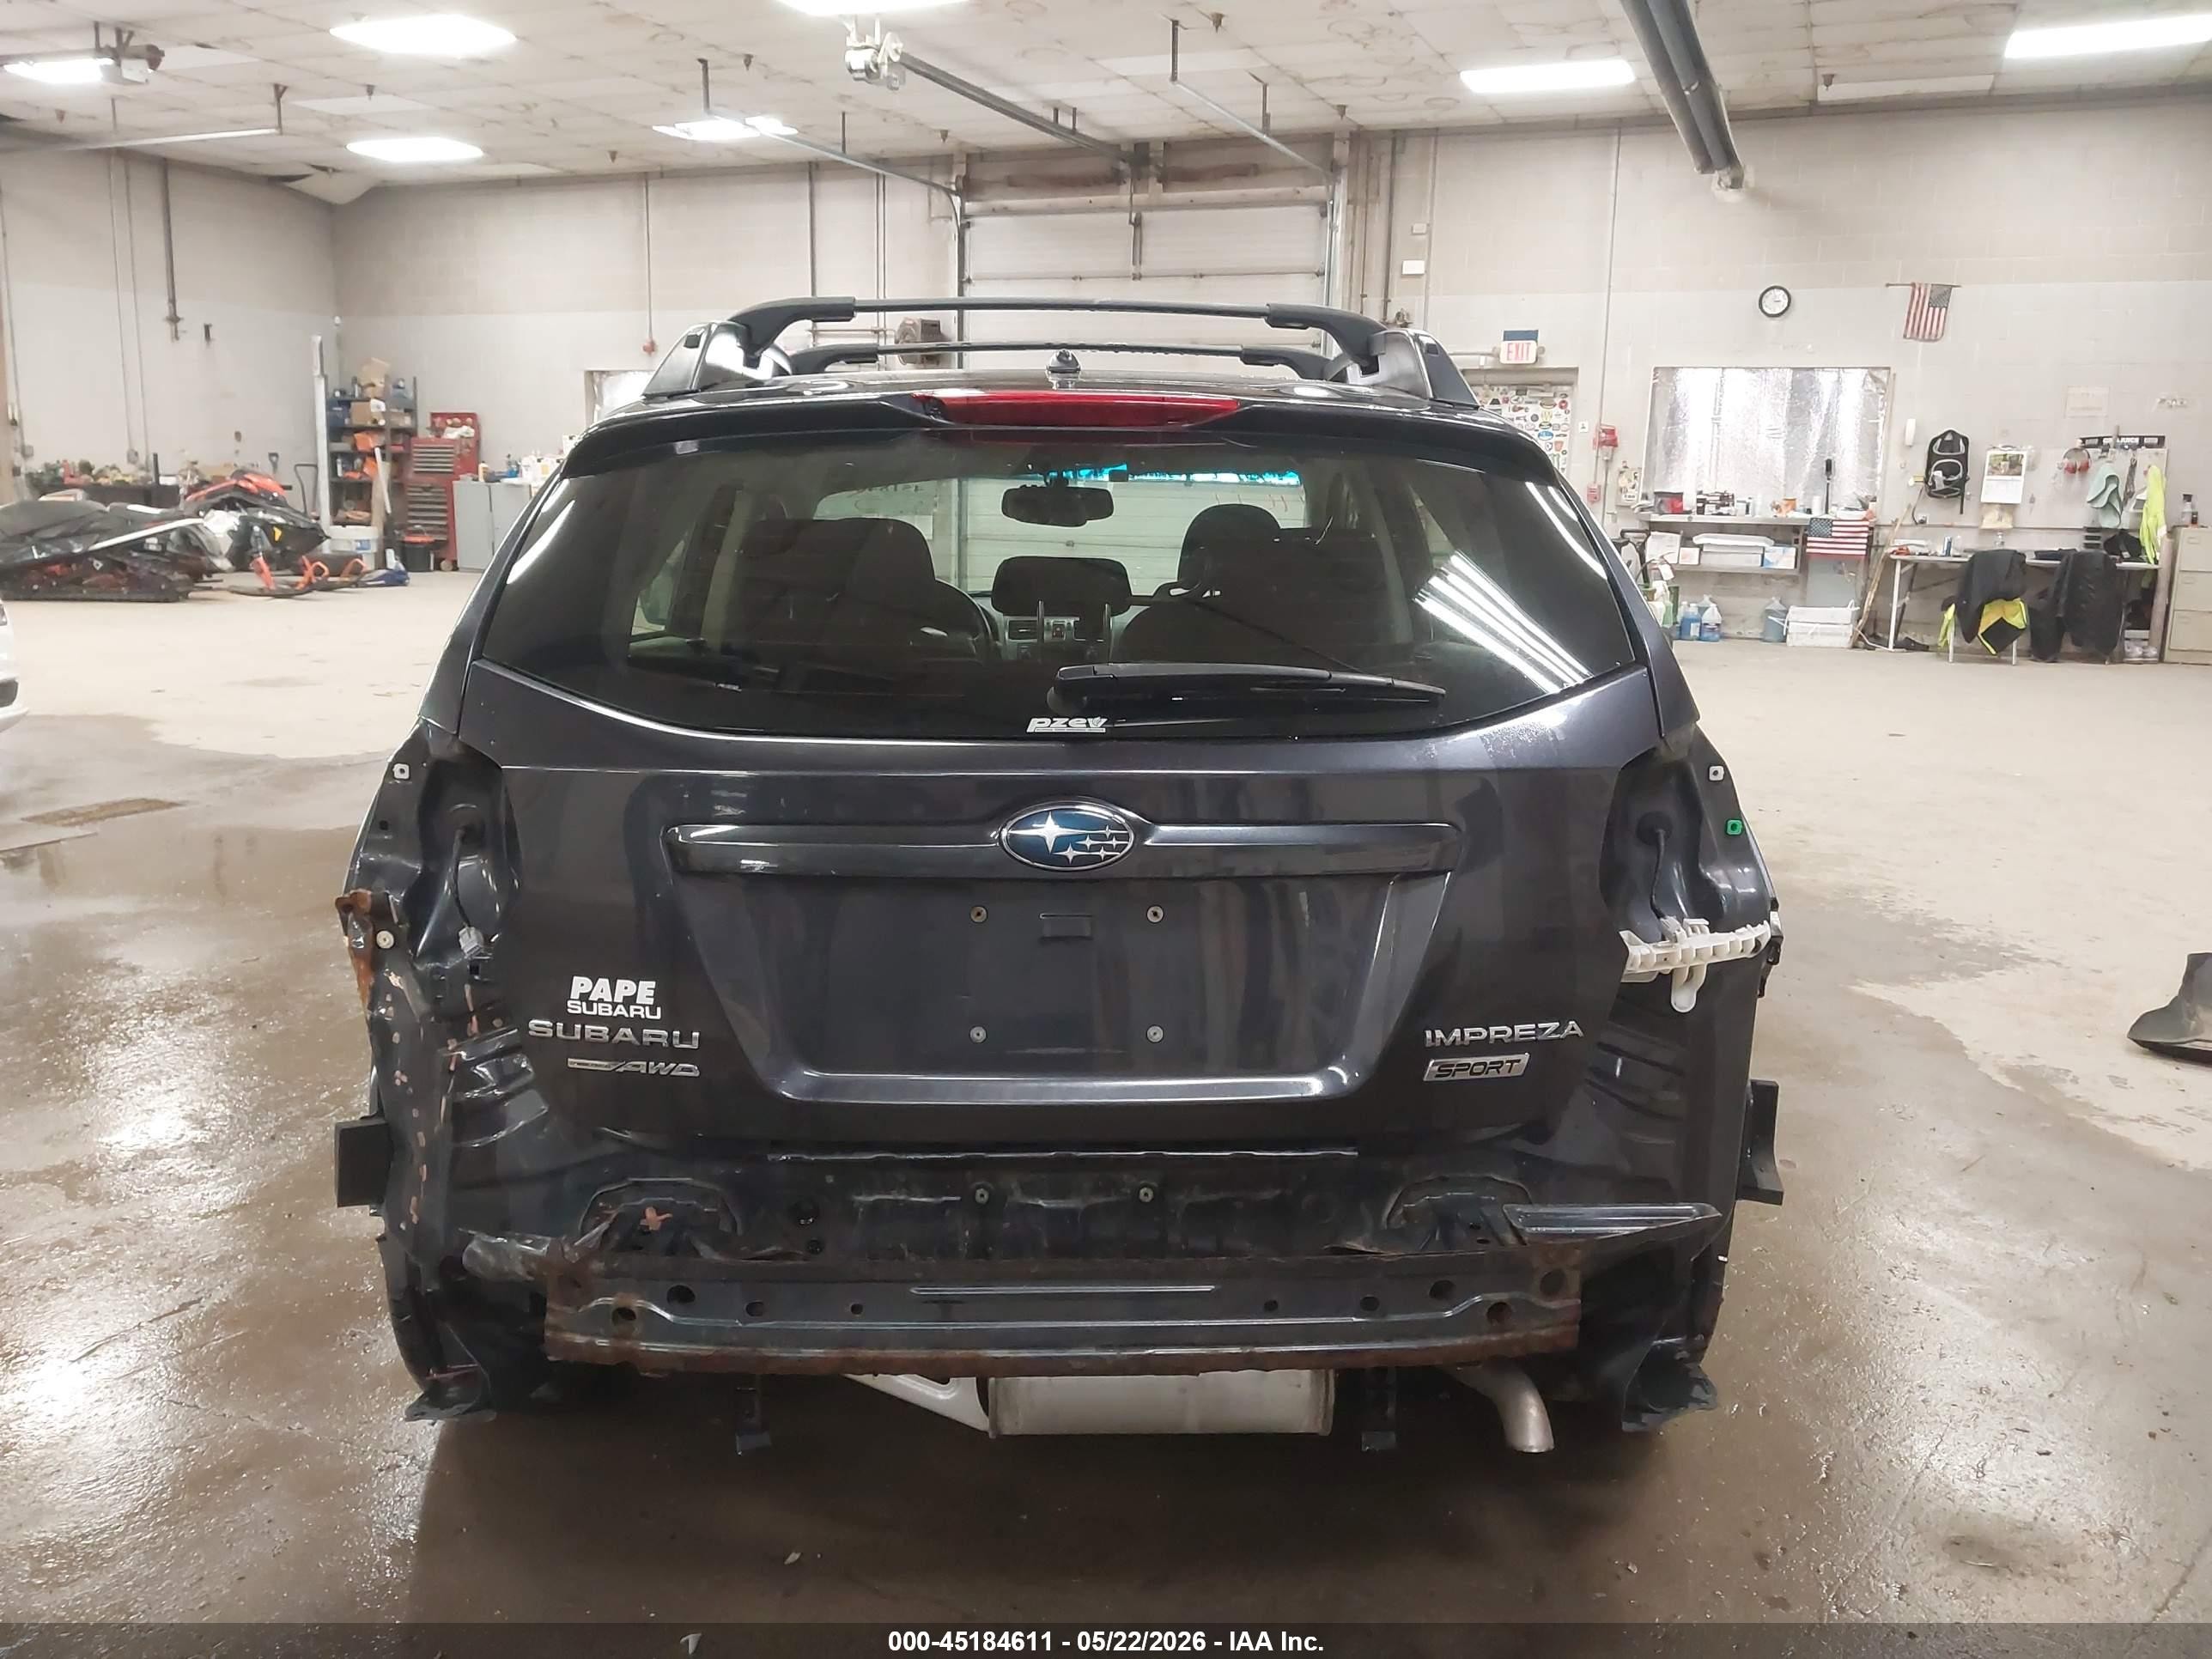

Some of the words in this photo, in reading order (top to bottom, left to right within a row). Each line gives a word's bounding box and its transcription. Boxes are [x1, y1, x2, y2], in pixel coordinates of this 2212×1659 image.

[1507, 342, 1532, 362] EXIT
[1026, 716, 1108, 732] pzev
[569, 975, 656, 1006] PAPE
[567, 1000, 661, 1019] SUBARU
[528, 1019, 700, 1049] SUBARU
[1425, 1020, 1584, 1048] IMPREZA
[616, 1060, 701, 1077] AWD
[1434, 1059, 1522, 1079] SPORT
